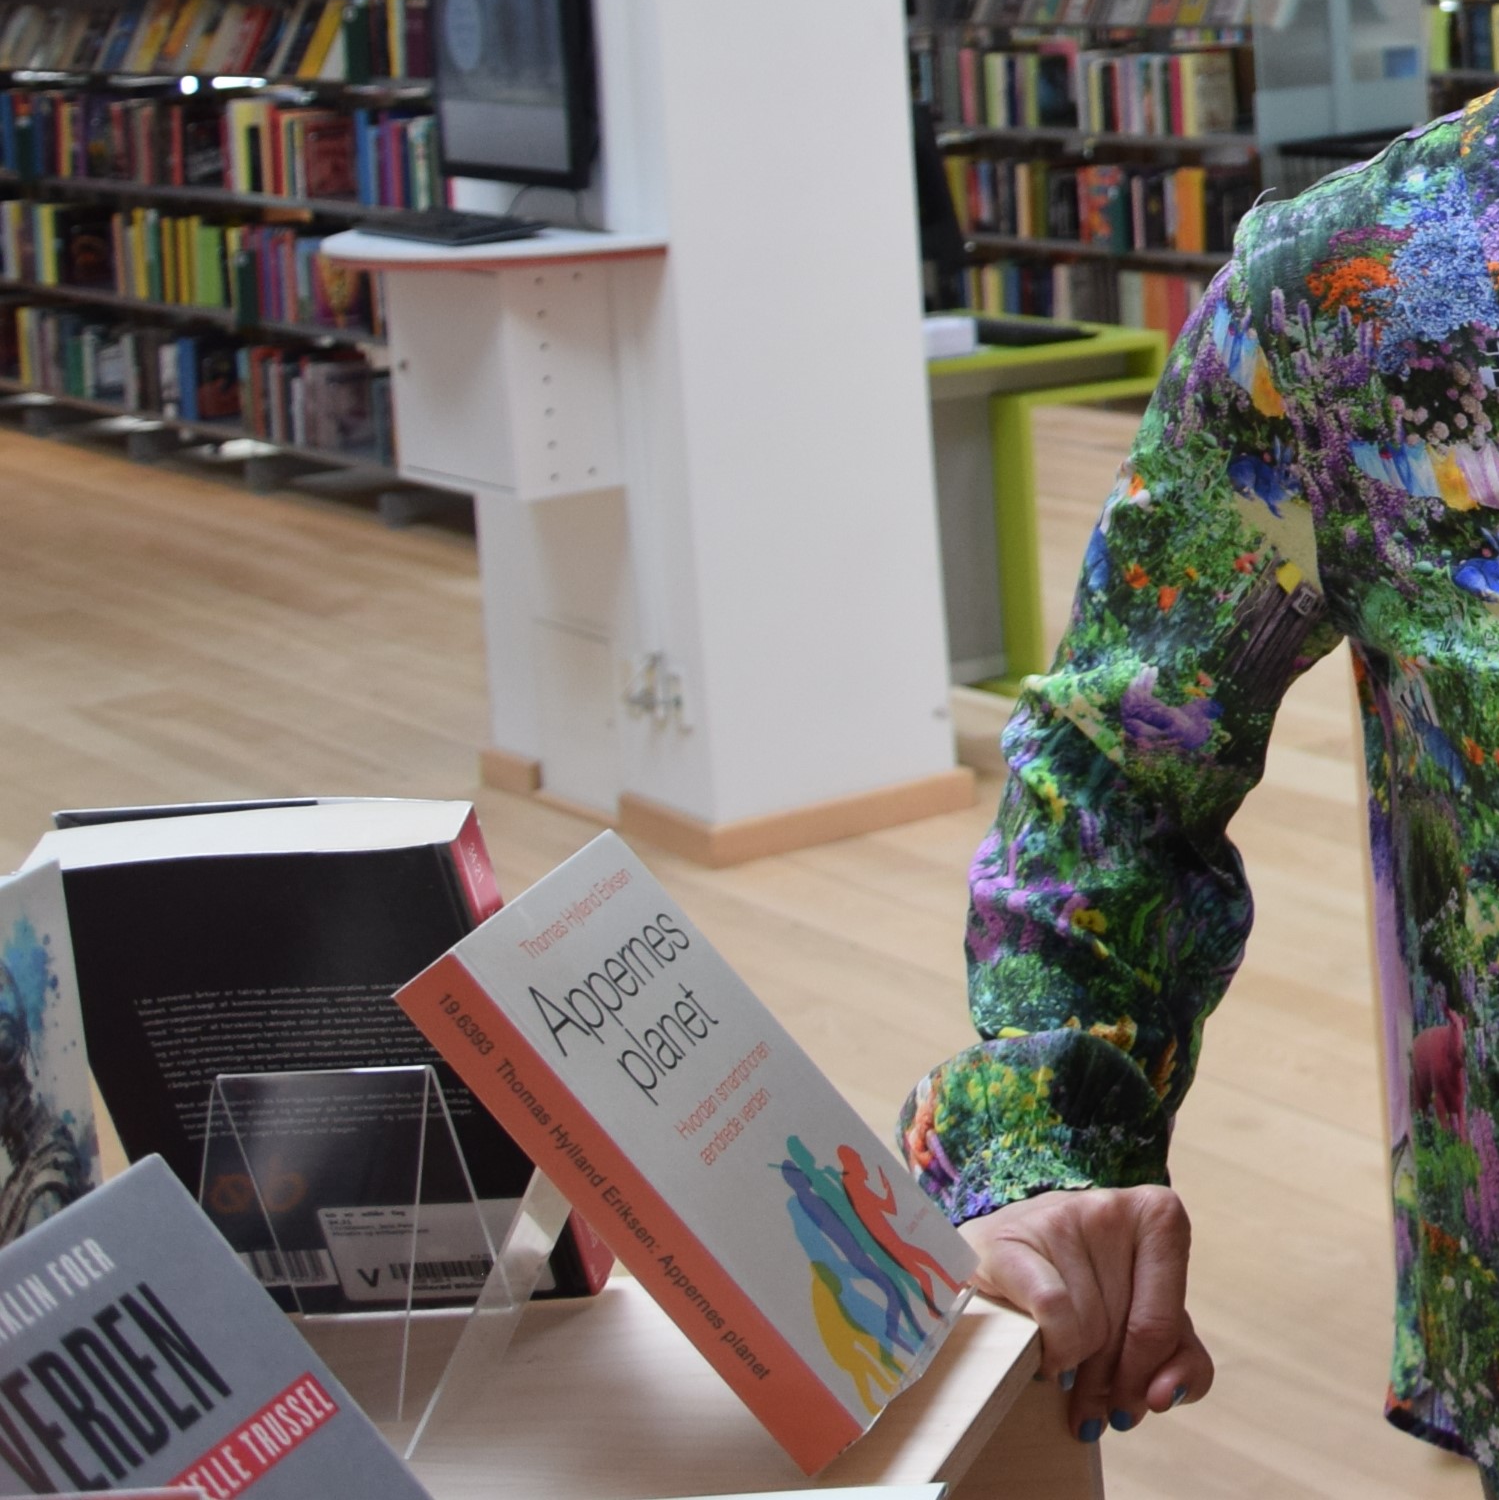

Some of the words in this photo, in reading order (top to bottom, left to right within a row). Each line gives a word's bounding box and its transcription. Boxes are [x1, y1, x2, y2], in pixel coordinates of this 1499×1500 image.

[518, 921, 569, 959] Thomas
[559, 889, 604, 926] Hylland
[593, 867, 633, 902] Eriksen
[528, 913, 690, 1057] Appernes
[616, 982, 719, 1107] planet
[673, 1094, 722, 1141] Hvordan
[738, 1086, 772, 1123] verden
[437, 993, 495, 1056] 19.6393
[496, 1057, 552, 1127] Thomas
[549, 1123, 608, 1188] Hylland
[657, 1254, 726, 1331] Appernes
[720, 1329, 771, 1381] planet
[46, 1238, 116, 1298] FOER
[358, 1268, 380, 1288] V
[238, 1380, 334, 1465] TRUSSEL
